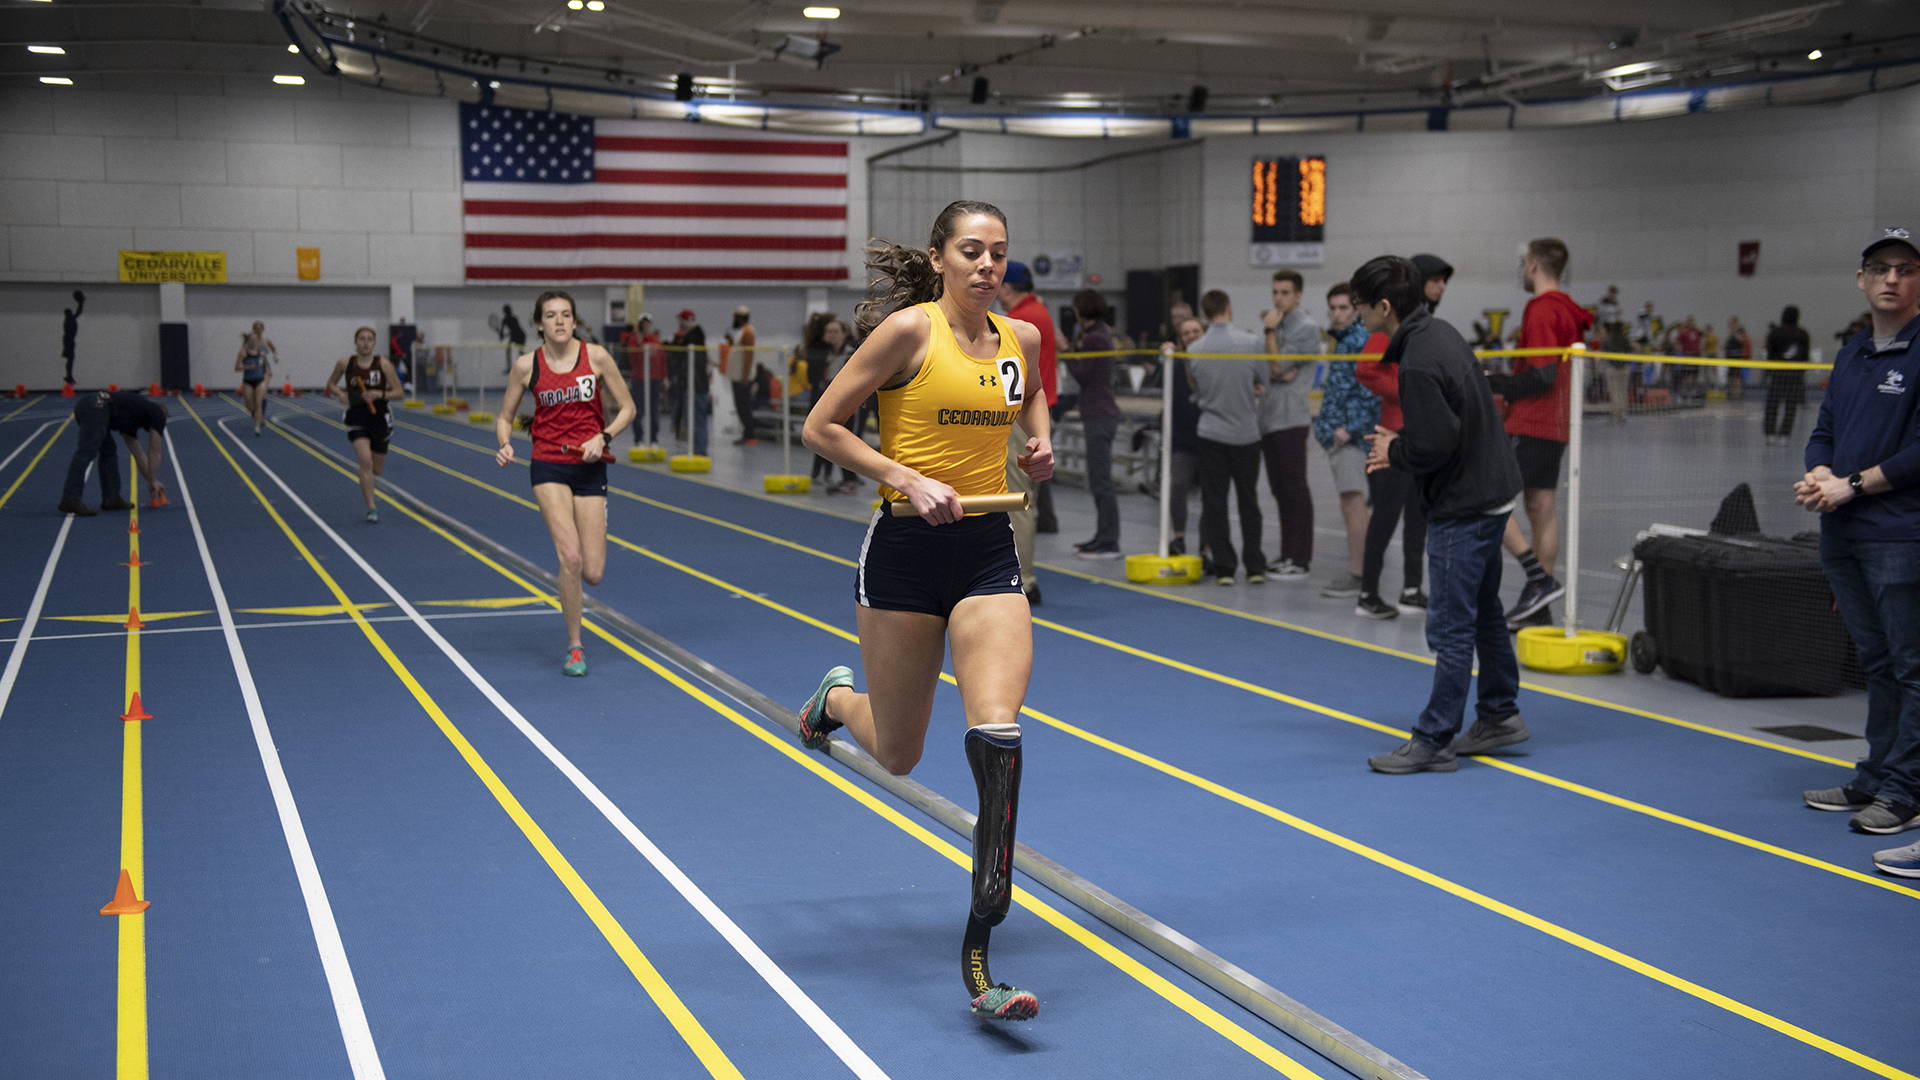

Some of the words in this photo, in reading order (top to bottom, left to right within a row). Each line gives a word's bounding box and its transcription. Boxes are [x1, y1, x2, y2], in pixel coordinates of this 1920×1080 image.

[124, 258, 222, 271] CEDARVILLE
[129, 271, 207, 282] UNIVERSITY
[372, 372, 379, 383] 4
[1001, 361, 1022, 401] 2
[582, 378, 594, 398] 3
[539, 386, 581, 407] TROJA
